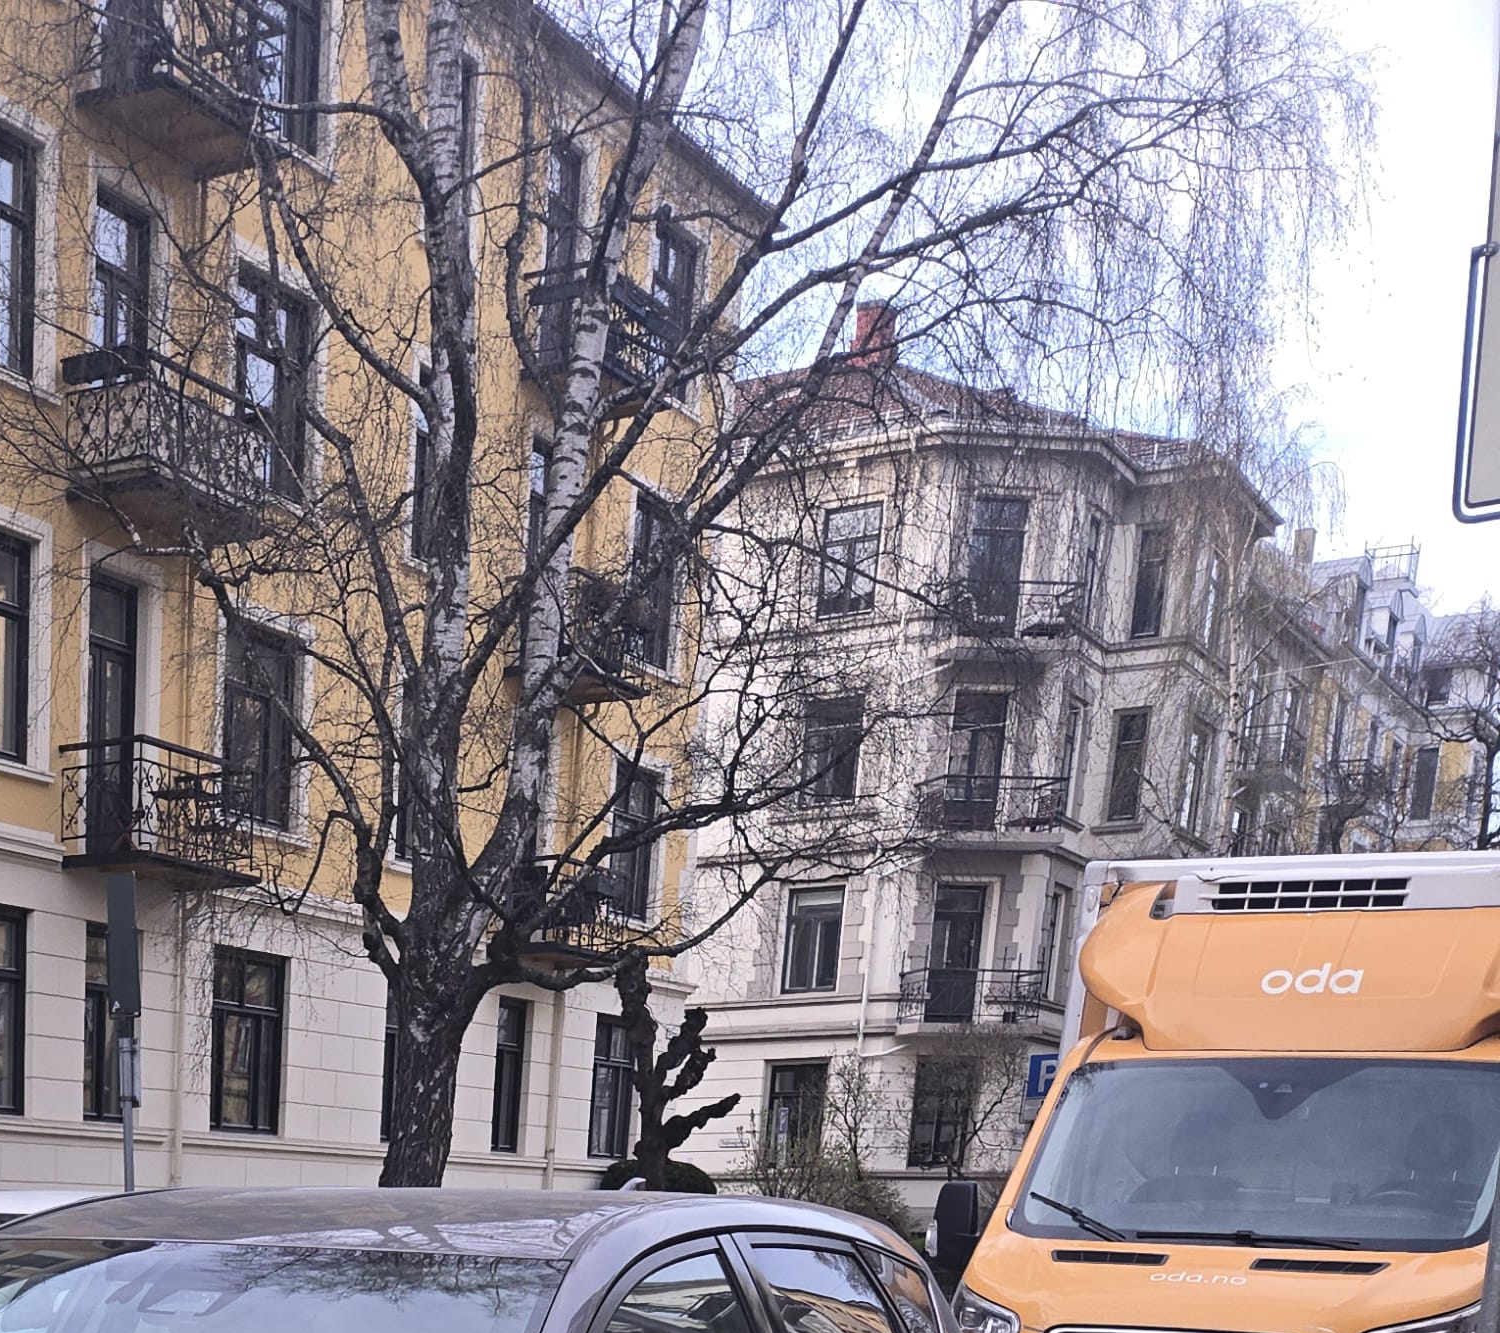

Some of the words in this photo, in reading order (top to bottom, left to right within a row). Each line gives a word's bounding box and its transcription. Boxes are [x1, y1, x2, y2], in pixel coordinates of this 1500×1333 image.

[1260, 962, 1364, 995] oda
[1038, 1060, 1057, 1093] P
[1150, 1272, 1246, 1285] oda.no
